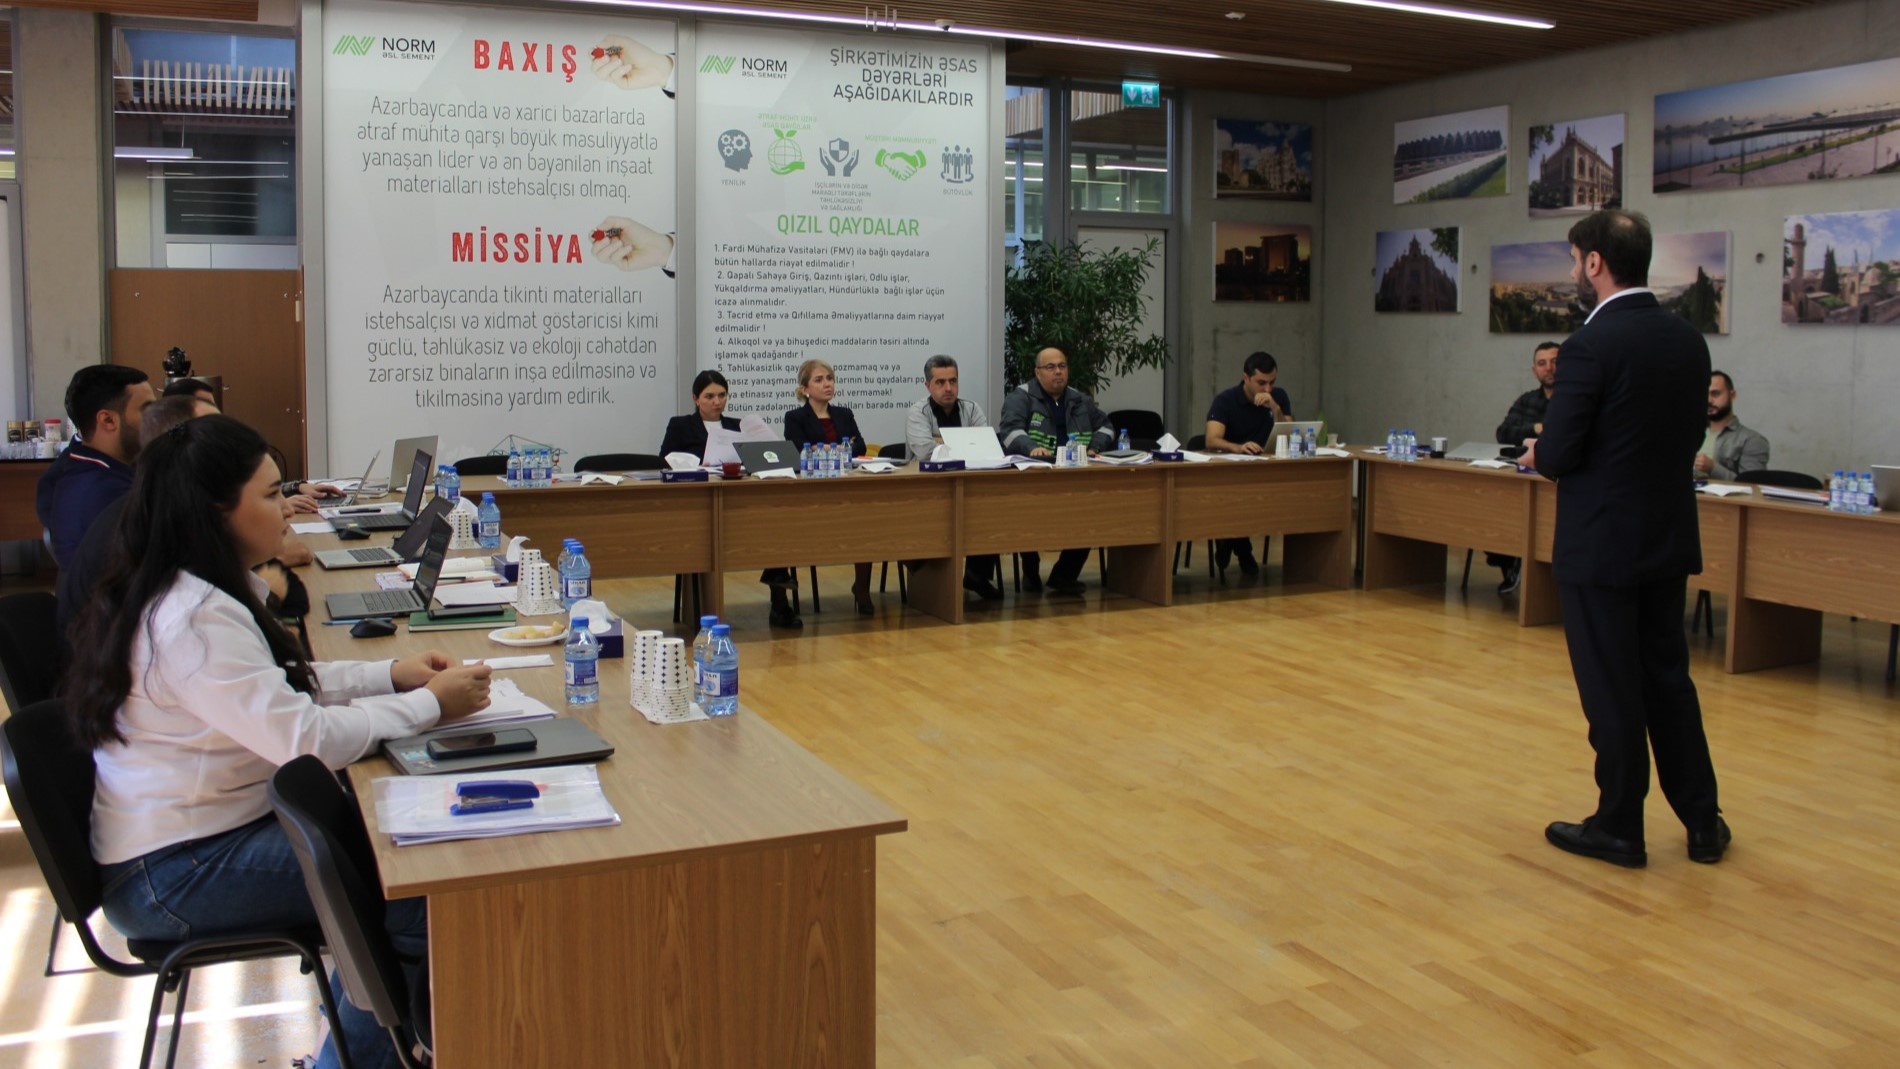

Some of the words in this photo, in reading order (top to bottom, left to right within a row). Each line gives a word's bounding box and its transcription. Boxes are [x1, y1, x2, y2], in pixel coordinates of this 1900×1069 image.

[383, 37, 435, 53] NORM
[474, 40, 576, 83] BAXIŞ
[743, 58, 787, 72] NORM
[830, 46, 933, 70] ŞİRKƏTİMİZİN
[938, 57, 978, 74] ƏSAS
[863, 68, 946, 88] DƏYƏRLƏRİ
[834, 84, 973, 106] AŞAĞIDAKILARDIR
[371, 96, 487, 125] Azərbaycanda
[493, 106, 510, 120] və
[516, 105, 556, 121] xarici
[563, 105, 645, 125] bazarlarda
[358, 121, 397, 140] ətraf
[403, 123, 459, 144] mühitə
[465, 130, 504, 149] qarşı
[511, 127, 556, 151] böyük
[563, 131, 657, 155] məsuliyyətlə
[363, 152, 432, 172] yanaşan
[439, 152, 474, 168] lider
[480, 156, 497, 169] və
[503, 156, 521, 170] ən
[528, 154, 600, 176] bəyənilən
[607, 157, 652, 176] inşaat
[388, 176, 481, 194] materialları
[488, 178, 574, 199] istehsalçısı
[580, 182, 630, 204] olmaq.
[778, 215, 822, 235] QIZIL
[830, 216, 919, 236] QAYDALAR
[452, 226, 582, 263] MİSSİYA
[723, 244, 744, 252] Fərdi
[748, 244, 785, 253] Mühafizə
[831, 246, 854, 256] (FMV)
[869, 248, 888, 258] bağlı
[891, 249, 929, 258] qaydalara
[715, 257, 739, 266] bütün
[742, 258, 776, 266] hallarda
[780, 259, 802, 268] riayət
[806, 259, 849, 268] edilməlidir
[757, 271, 787, 281] Sahəyə
[814, 272, 842, 280] Qazıntı
[870, 273, 888, 281] Odlu
[383, 285, 498, 309] Azərbaycanda
[504, 285, 547, 303] tikinti
[554, 286, 641, 304] materialları
[715, 284, 767, 294] Yükqaldırma
[829, 285, 879, 294] Hündürlüklə
[884, 286, 903, 296] bağlı
[906, 287, 923, 296] işlər
[926, 288, 944, 296] üçün
[366, 312, 455, 332] istehsalçısı
[461, 315, 479, 329] və
[485, 312, 537, 329] xidmət
[543, 312, 621, 335] göstəricisi
[628, 312, 657, 328] kimi
[727, 310, 753, 319] Təcrid
[897, 312, 915, 320] daim
[715, 324, 760, 332] edilməlidir
[368, 338, 416, 362] güclü,
[423, 337, 504, 355] təhlükəsiz
[510, 341, 527, 354] və
[533, 337, 580, 360] ekoloji
[587, 336, 656, 354] cəhətdən
[728, 337, 760, 347] Alkoqol
[775, 339, 784, 347] ya
[787, 337, 828, 347] bihuşedici
[832, 337, 877, 345] maddələrin
[903, 337, 929, 345] altında
[715, 351, 748, 360] işləmək
[752, 350, 798, 360] qadağandır
[369, 365, 433, 382] zərərsiz
[440, 362, 508, 381] binaların
[515, 363, 546, 383] inşa
[552, 362, 634, 379] edilməsinə
[640, 365, 656, 378] və
[728, 364, 782, 372] Təhlükəsizlik
[891, 365, 900, 373] ya
[877, 376, 913, 385] qaydaları
[416, 389, 502, 407] tikilməsinə
[508, 387, 561, 412] yardım
[568, 386, 614, 404] edirik.
[866, 401, 894, 409] barədə
